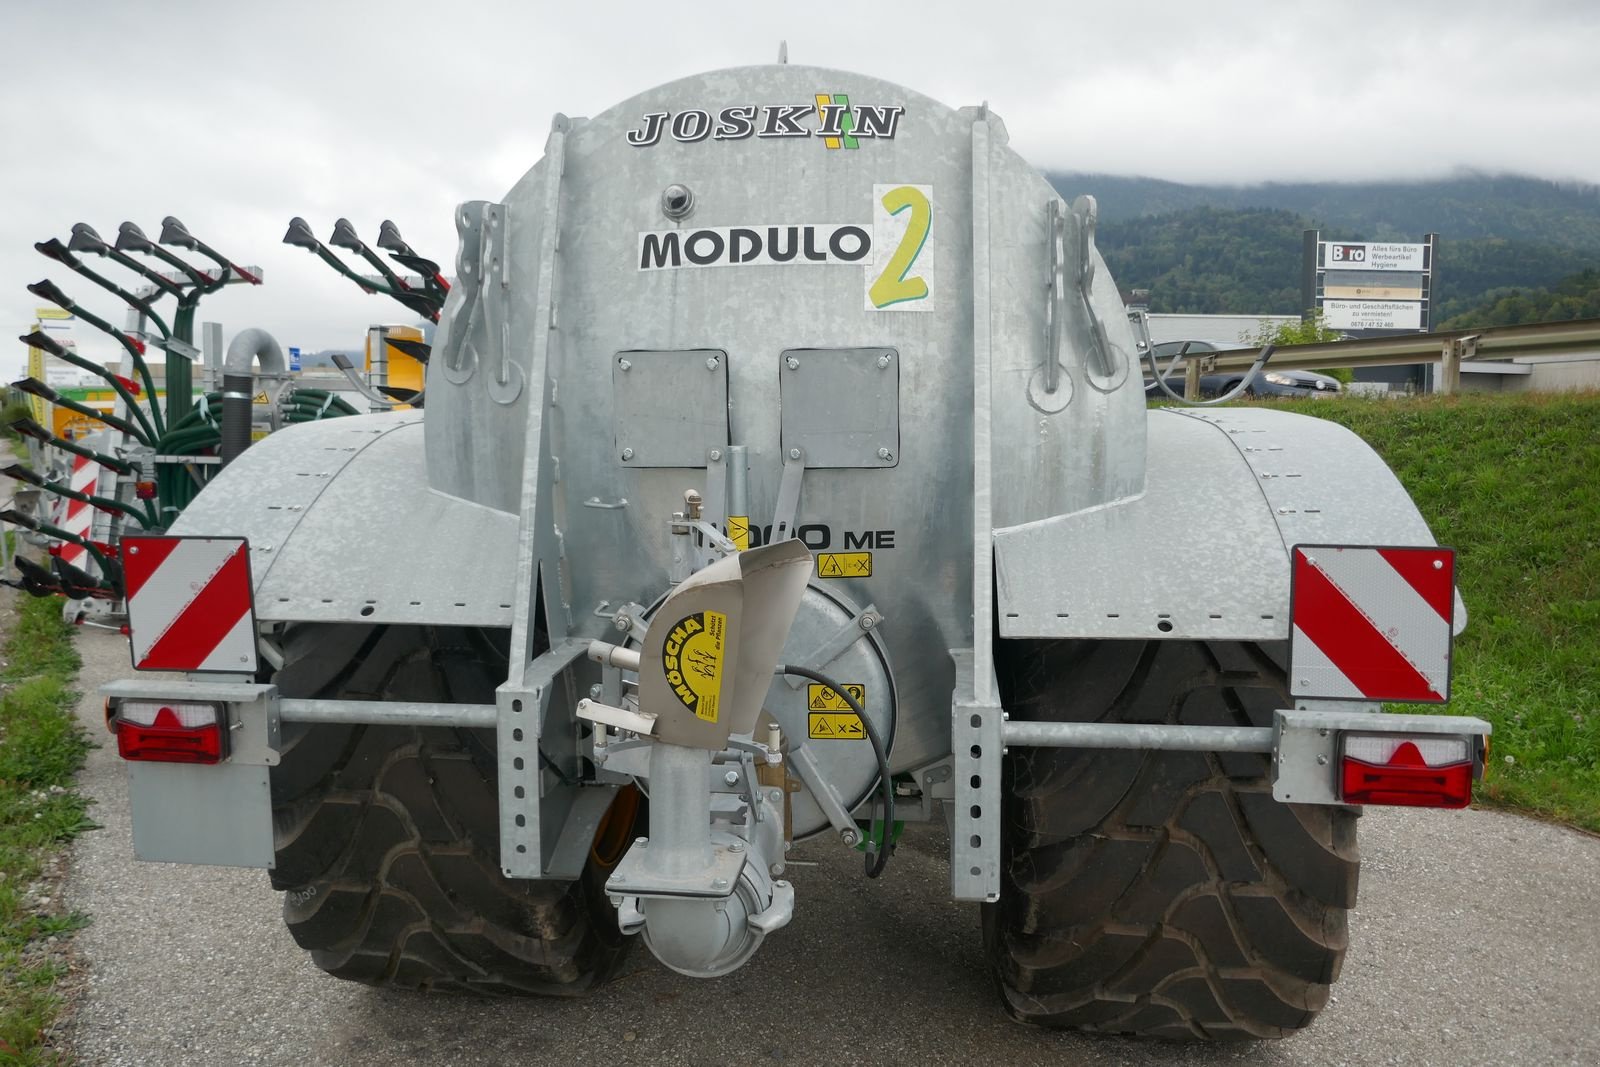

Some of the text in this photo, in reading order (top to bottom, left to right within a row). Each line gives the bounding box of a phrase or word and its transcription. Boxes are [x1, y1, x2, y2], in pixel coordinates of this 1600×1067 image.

[625, 104, 905, 147] JOSKIN
[640, 185, 932, 309] MODULO 2
[1371, 261, 1398, 269] Hygiene
[844, 530, 896, 550] ME
[665, 618, 703, 705] MÖSCHA
